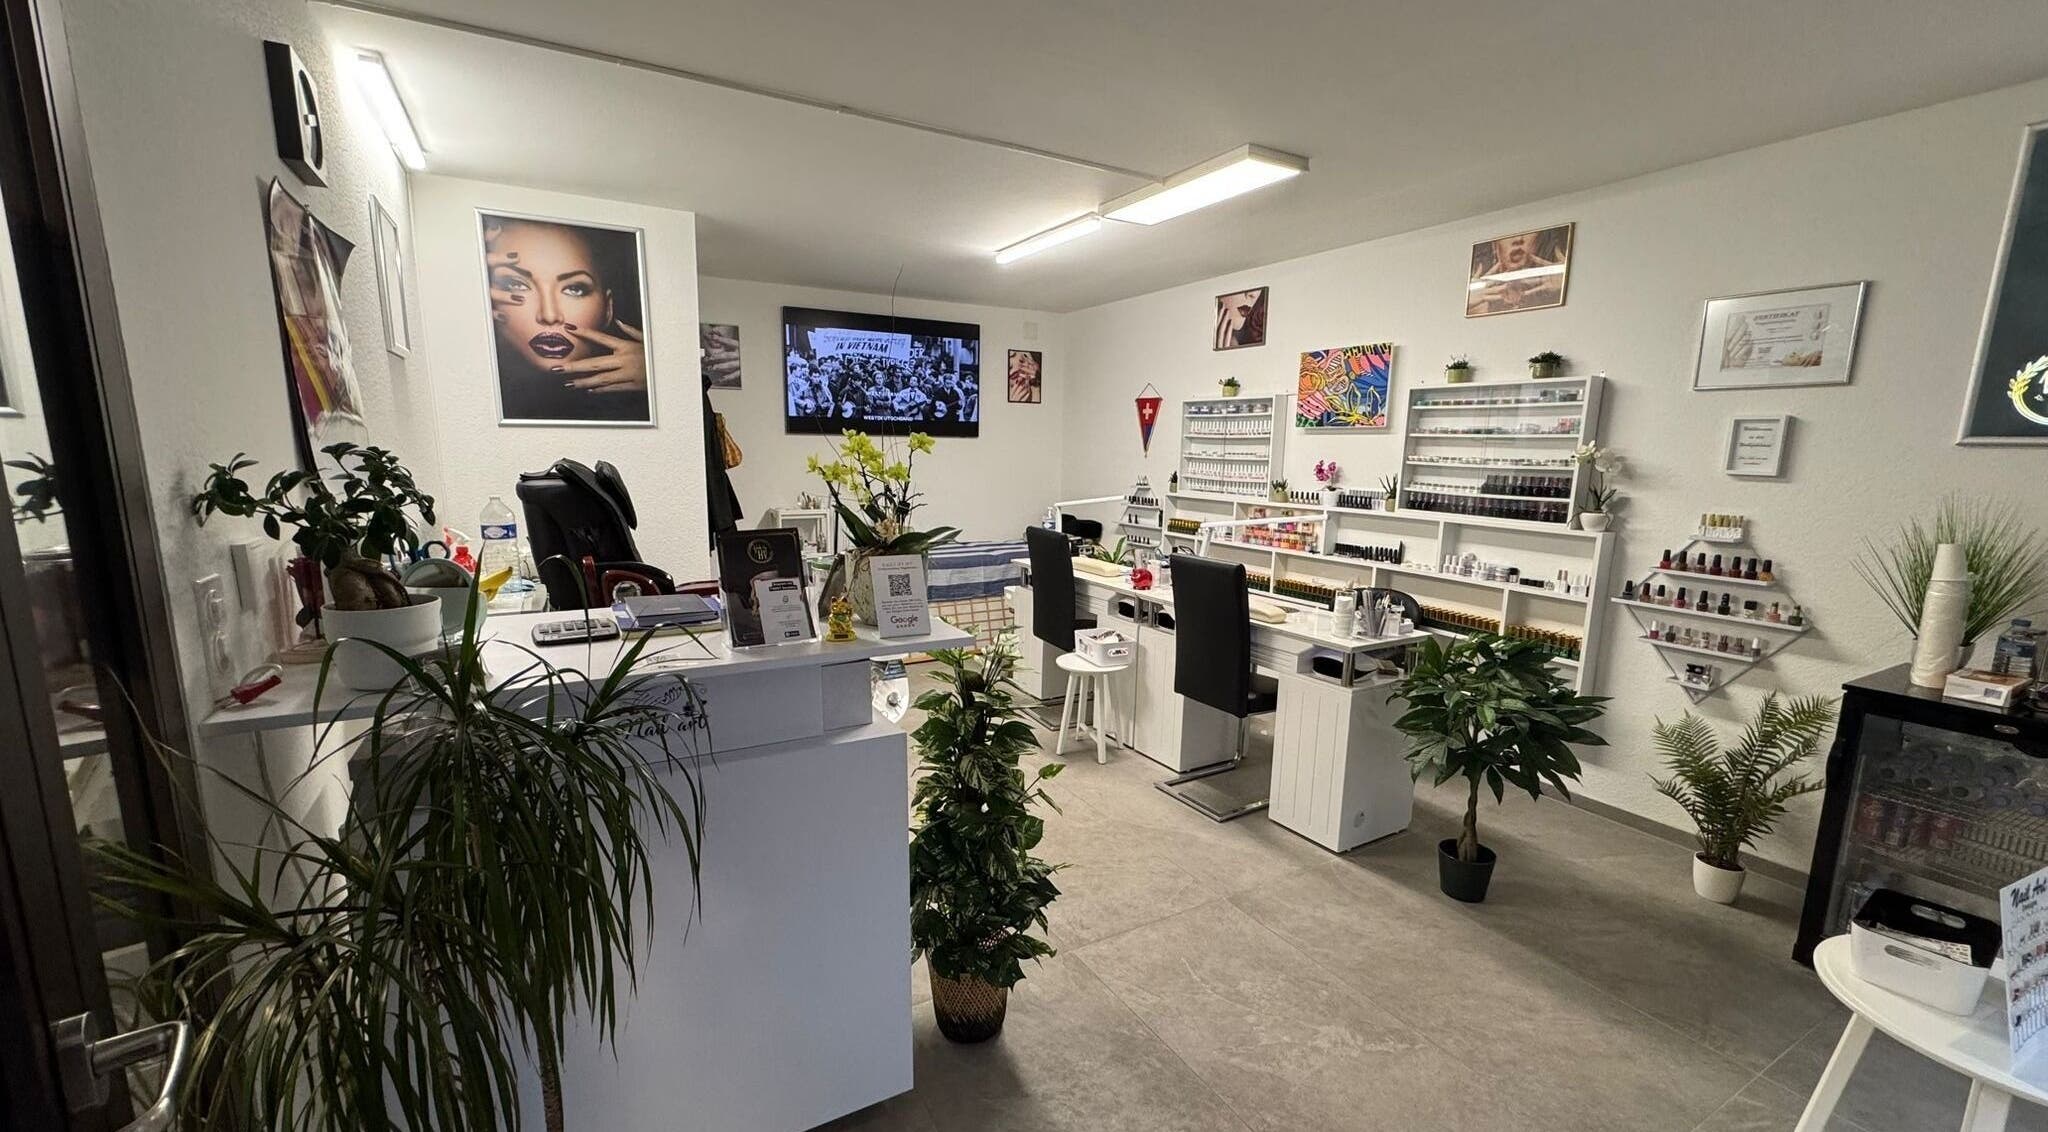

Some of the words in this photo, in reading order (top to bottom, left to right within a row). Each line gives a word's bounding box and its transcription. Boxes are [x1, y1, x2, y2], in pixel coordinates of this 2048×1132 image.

[835, 341, 844, 351] IN
[847, 341, 889, 353] VIETNAM
[890, 614, 919, 625] Google
